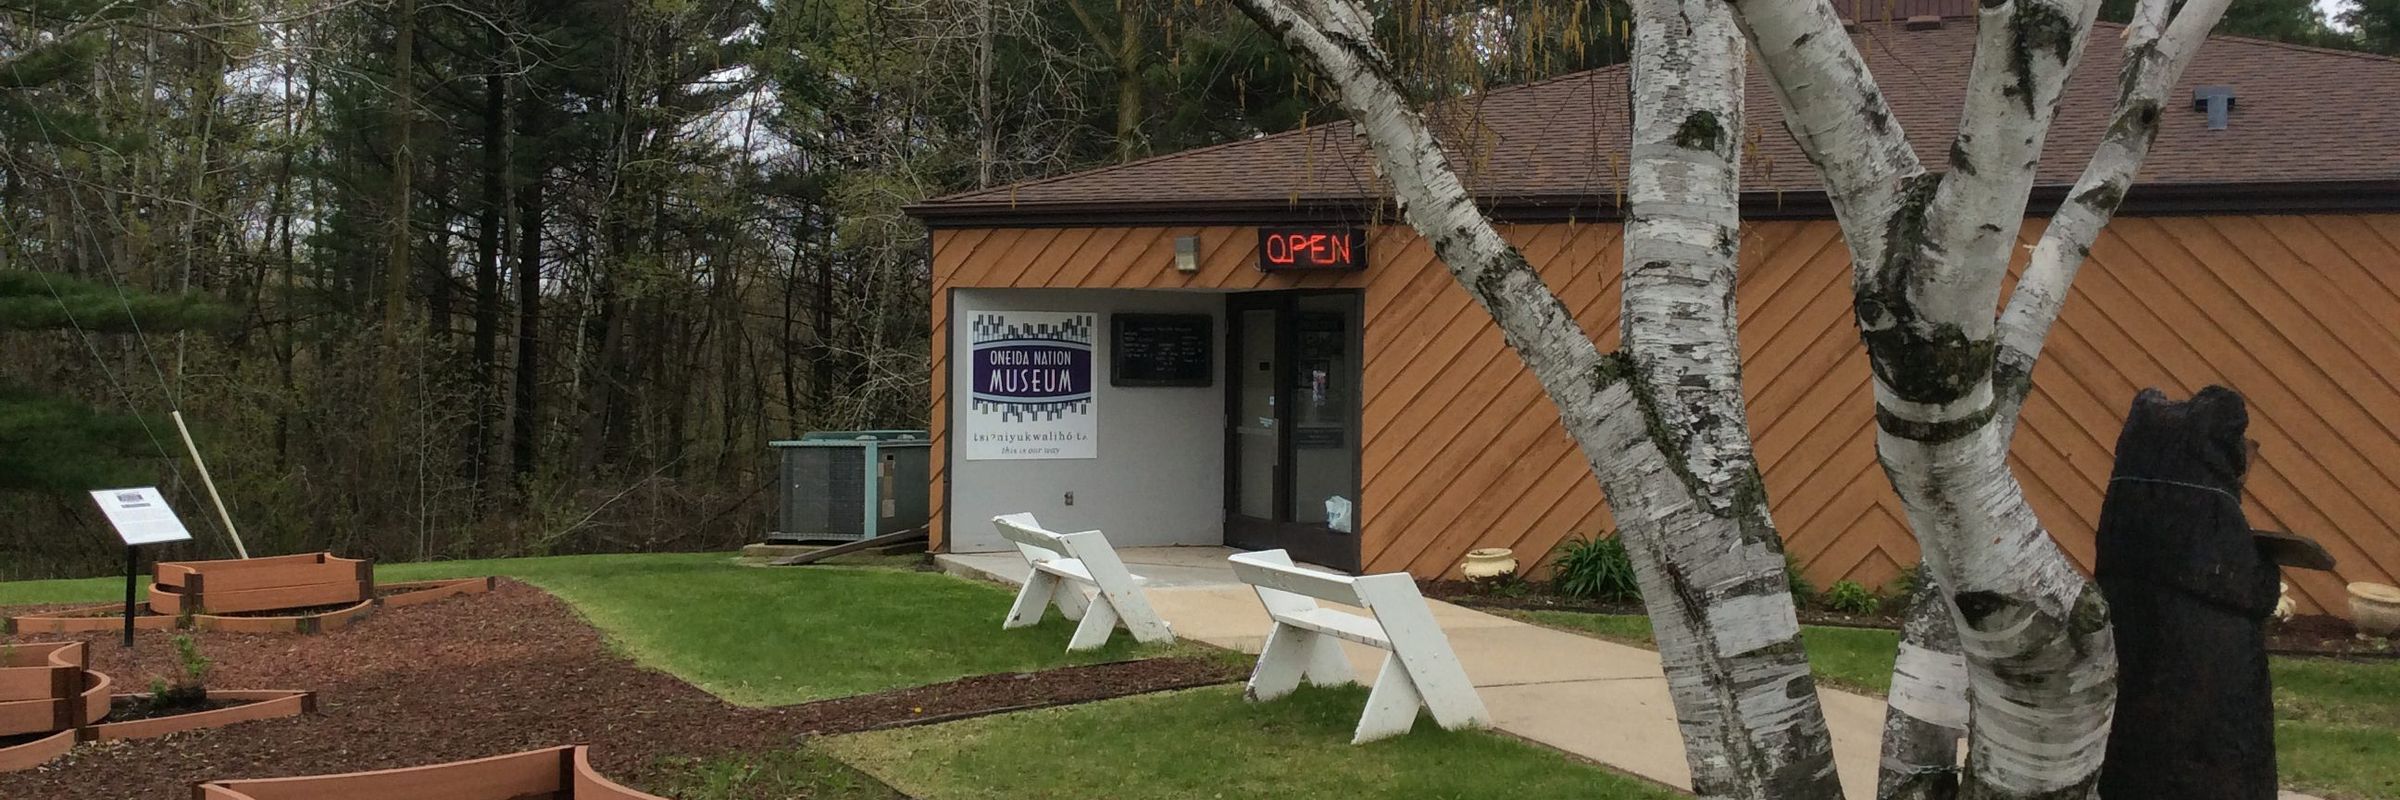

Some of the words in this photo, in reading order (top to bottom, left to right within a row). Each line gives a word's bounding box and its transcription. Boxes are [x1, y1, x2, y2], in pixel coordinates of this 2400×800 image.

[1267, 233, 1351, 264] OPEN
[990, 350, 1029, 366] ONEIDA
[1034, 350, 1072, 366] NATION
[989, 369, 1072, 393] MUSEUM
[1001, 445, 1017, 455] this
[1028, 447, 1043, 455] our
[1044, 447, 1060, 455] way
